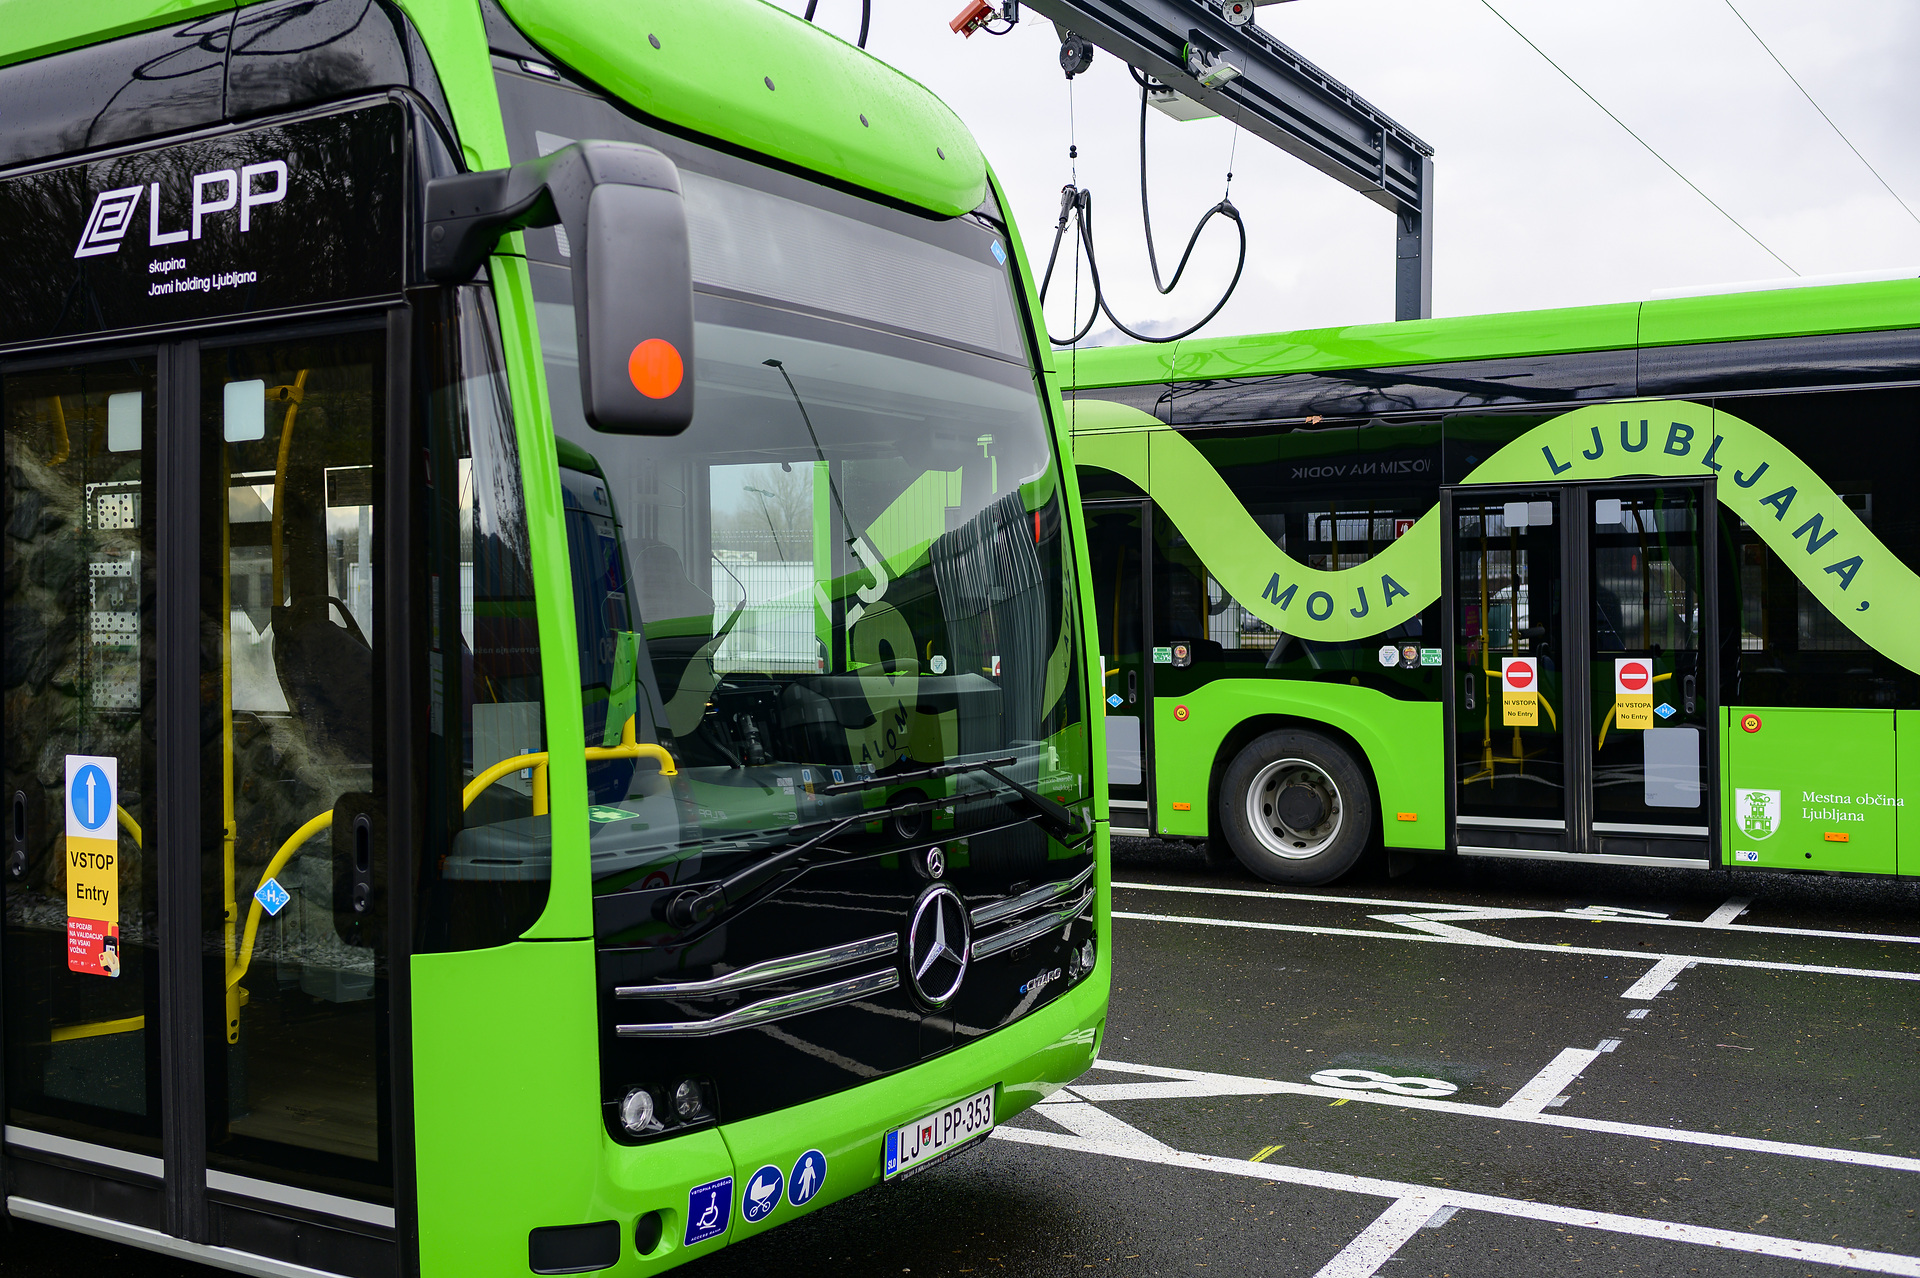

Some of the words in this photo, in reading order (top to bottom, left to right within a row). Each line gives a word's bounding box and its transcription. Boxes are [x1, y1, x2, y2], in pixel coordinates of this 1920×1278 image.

[150, 160, 288, 246] LPP
[149, 258, 186, 275] skupina
[148, 280, 174, 297] Javni
[175, 276, 211, 294] holding
[212, 270, 257, 290] Ljubljana
[1541, 419, 1871, 613] LJUBLJANA,
[1262, 572, 1410, 621] MOJA
[1802, 791, 1851, 804] Mestna
[1855, 793, 1905, 807] občina
[1802, 807, 1864, 824] Ljubljana
[70, 851, 114, 871] VSTOP
[76, 883, 109, 905] Entry
[76, 922, 92, 931] POZABI
[76, 931, 104, 941] VALIDACIJO
[77, 939, 91, 947] VSAKI
[1310, 1067, 1458, 1097] 8
[900, 1125, 920, 1163] LJ
[934, 1094, 990, 1148] LPP-353
[887, 1158, 896, 1170] SLO
